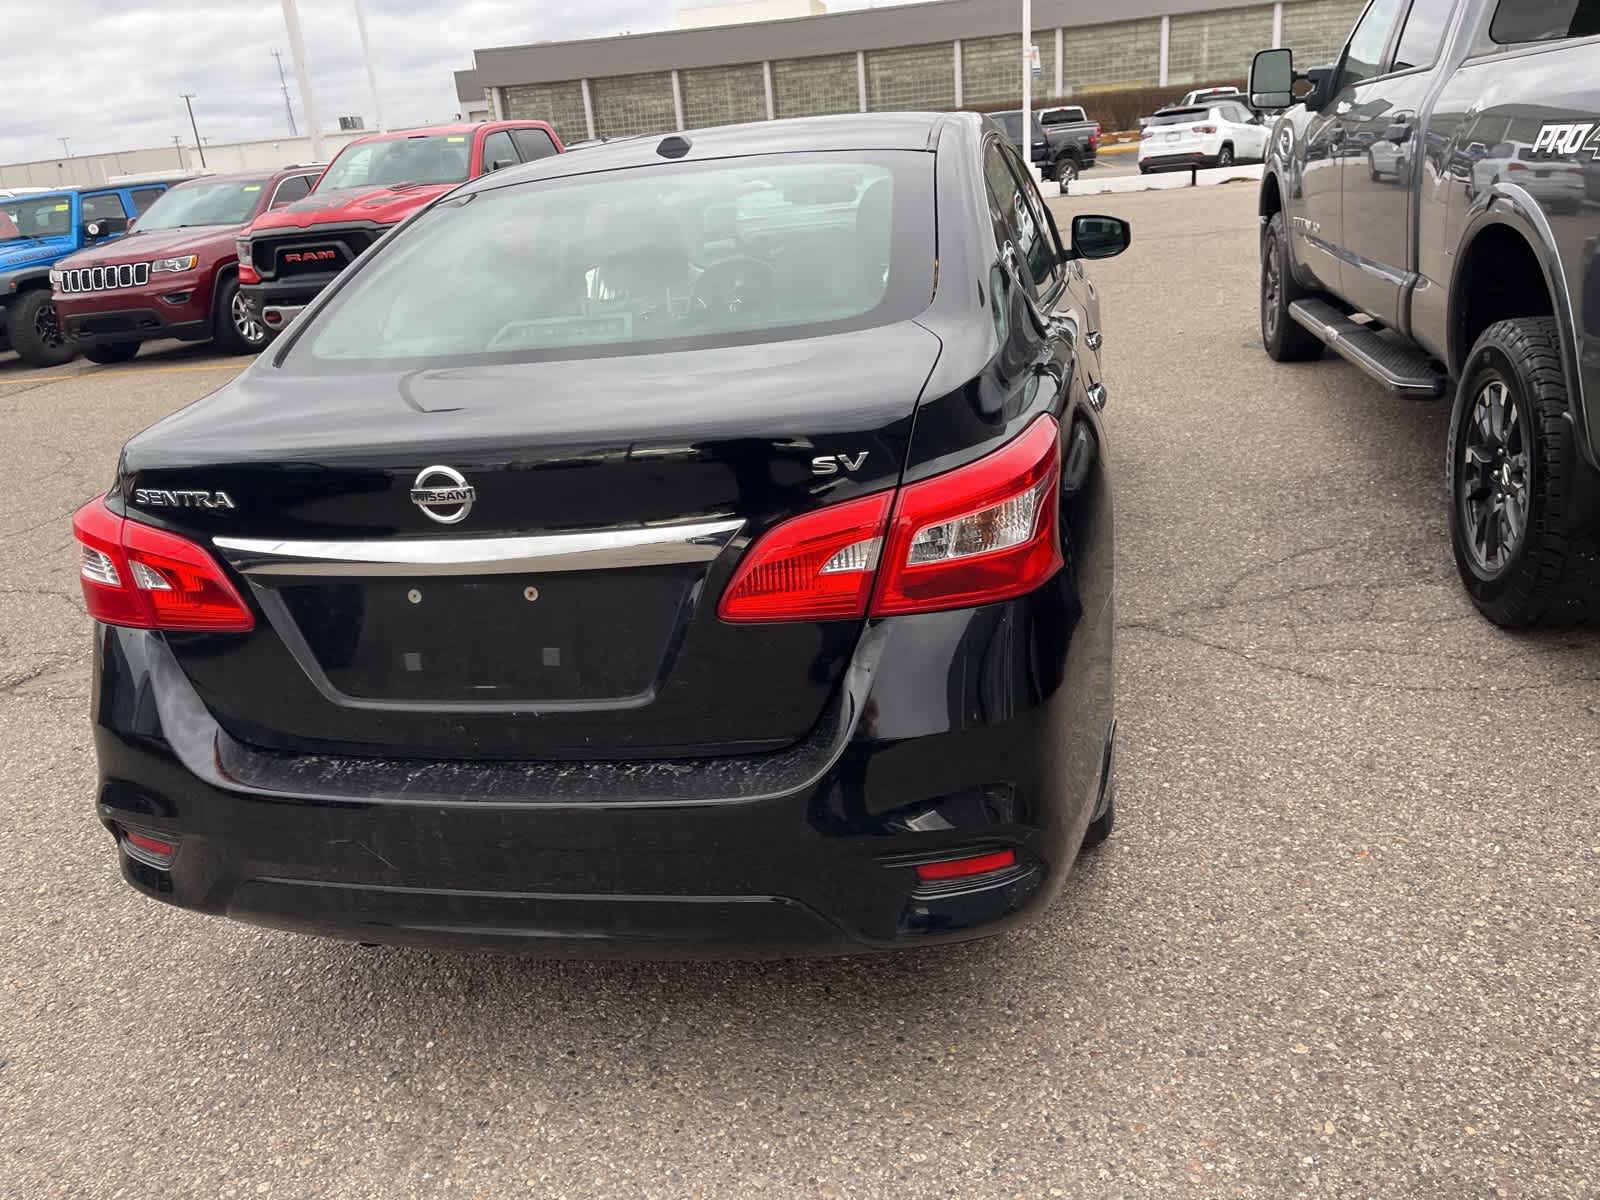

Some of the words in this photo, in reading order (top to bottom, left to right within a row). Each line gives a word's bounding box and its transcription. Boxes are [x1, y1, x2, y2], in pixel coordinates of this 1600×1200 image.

[285, 250, 336, 262] RAM
[811, 451, 869, 475] SV
[135, 489, 234, 508] SENTRA
[415, 488, 473, 502] NISSAN
